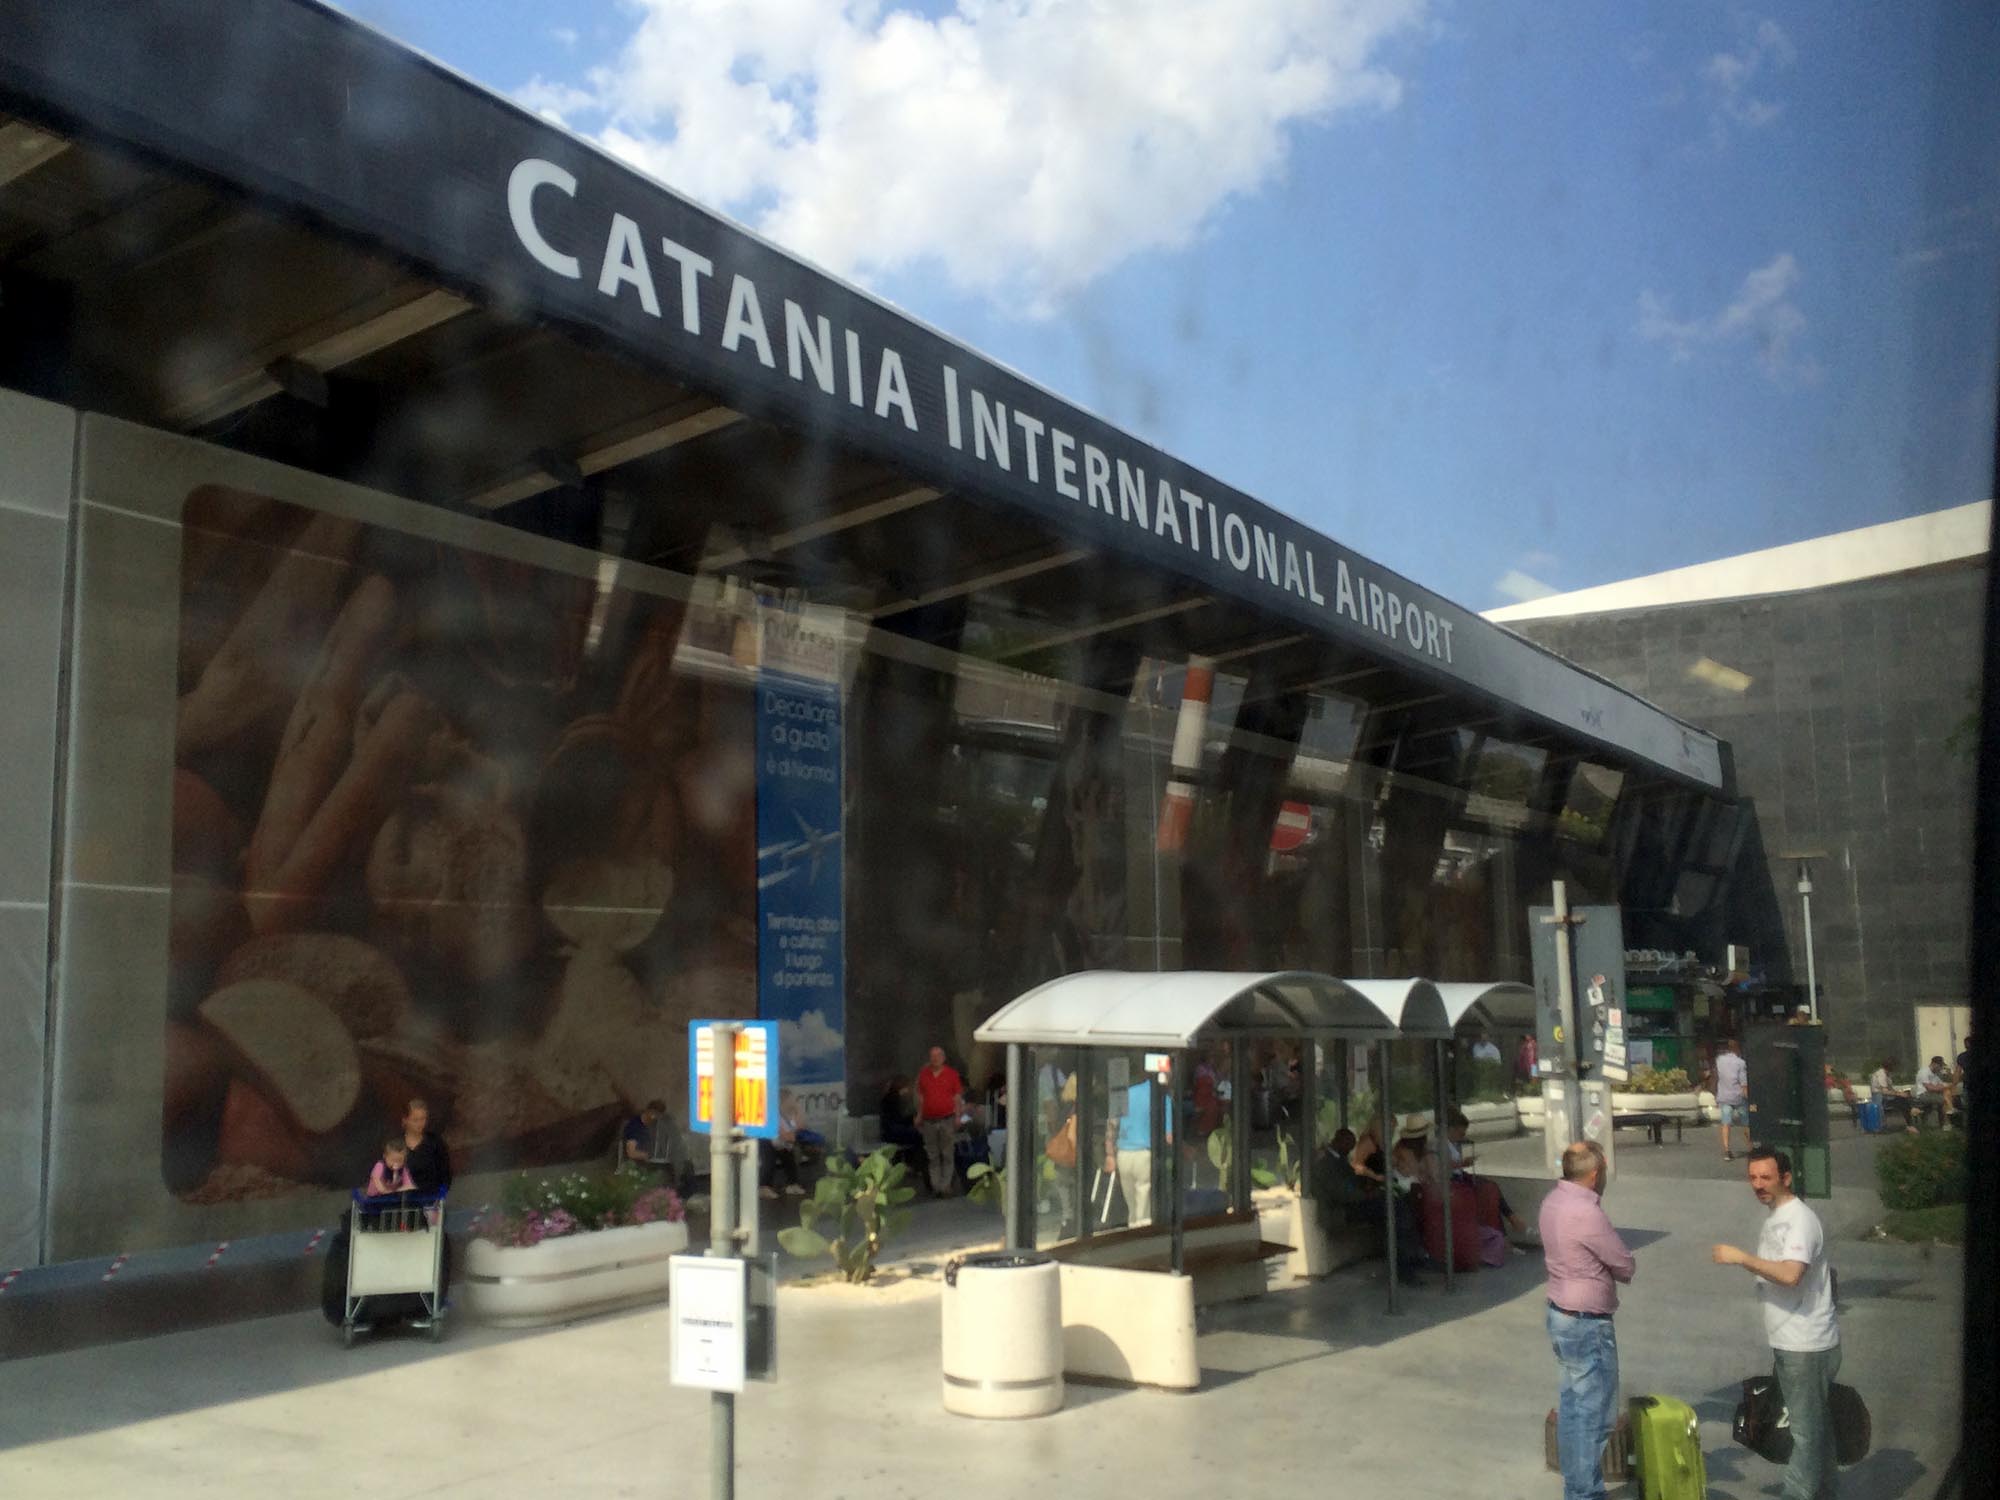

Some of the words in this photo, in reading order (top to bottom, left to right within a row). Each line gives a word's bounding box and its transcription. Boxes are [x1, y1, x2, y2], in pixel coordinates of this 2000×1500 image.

[507, 158, 918, 432] CATANIA
[943, 365, 1324, 607] INTERNATIONAL
[1336, 559, 1454, 664] AIRPORT
